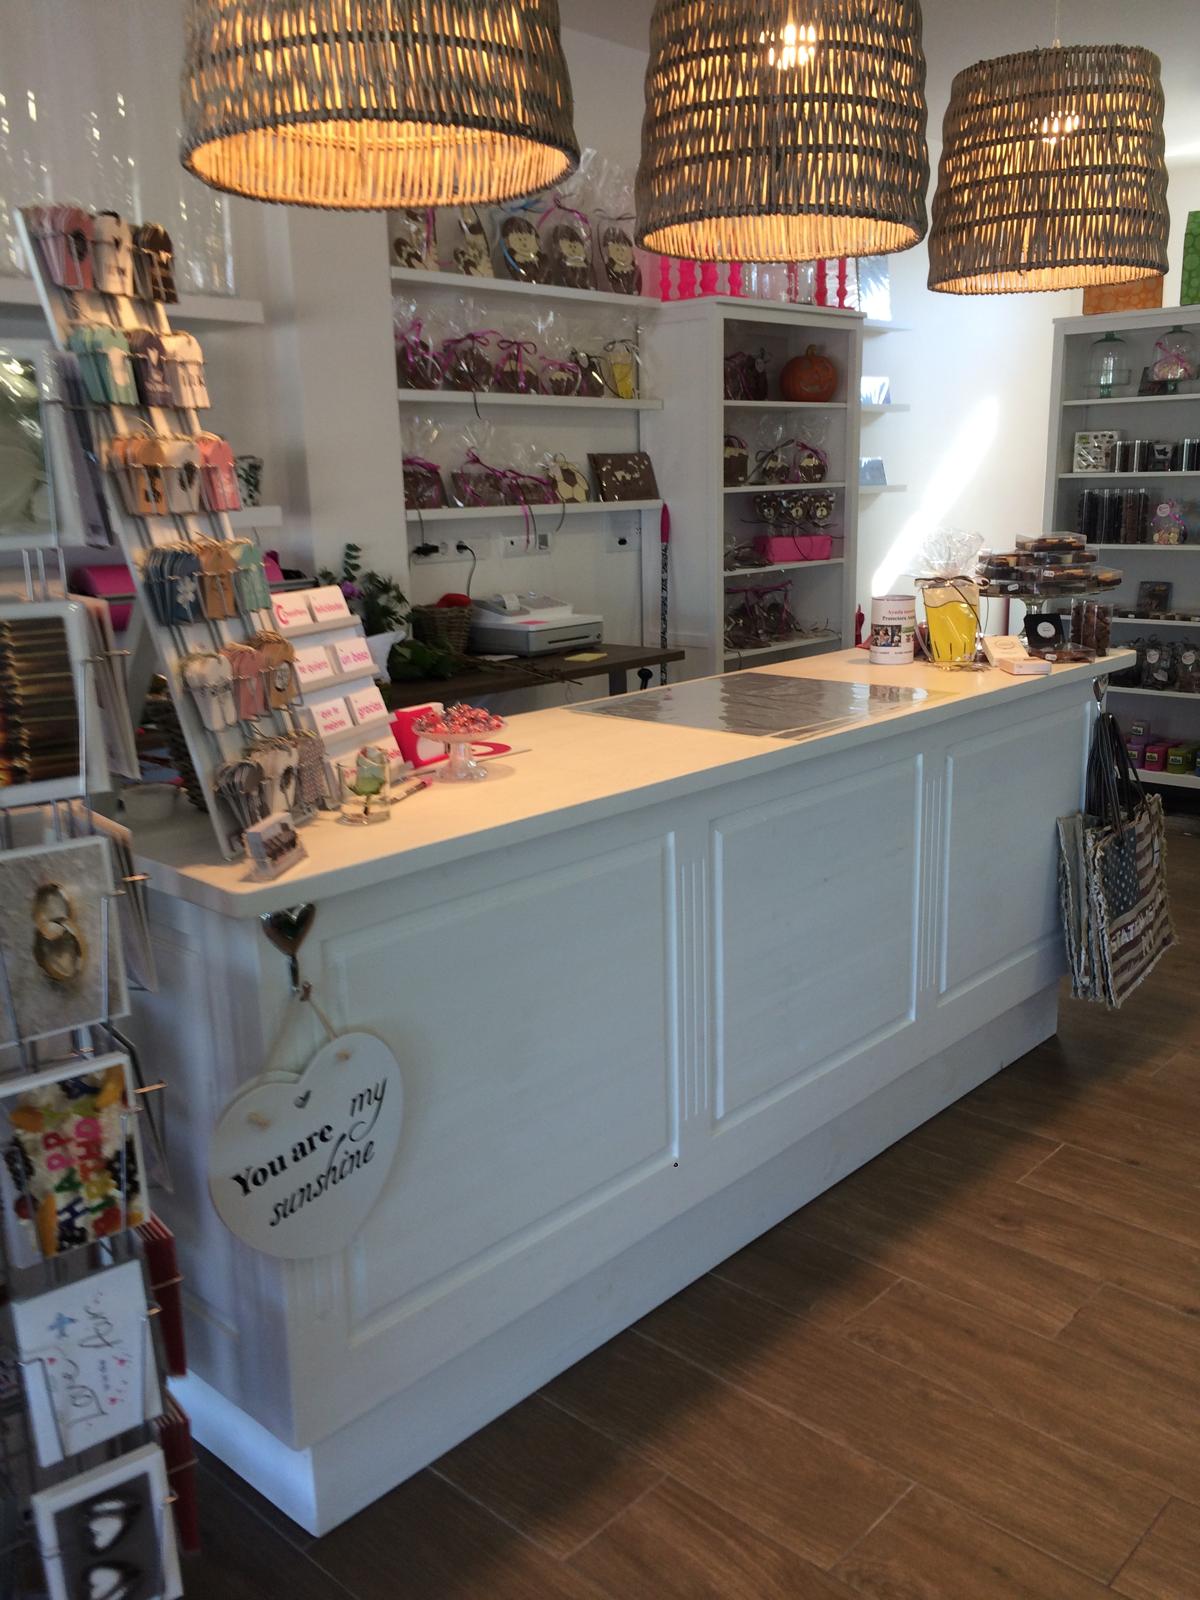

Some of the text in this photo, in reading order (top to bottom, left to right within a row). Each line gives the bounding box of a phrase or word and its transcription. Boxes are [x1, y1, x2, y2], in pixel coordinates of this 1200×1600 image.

[231, 1077, 388, 1197] You are my
[269, 1132, 375, 1228] sunshine
